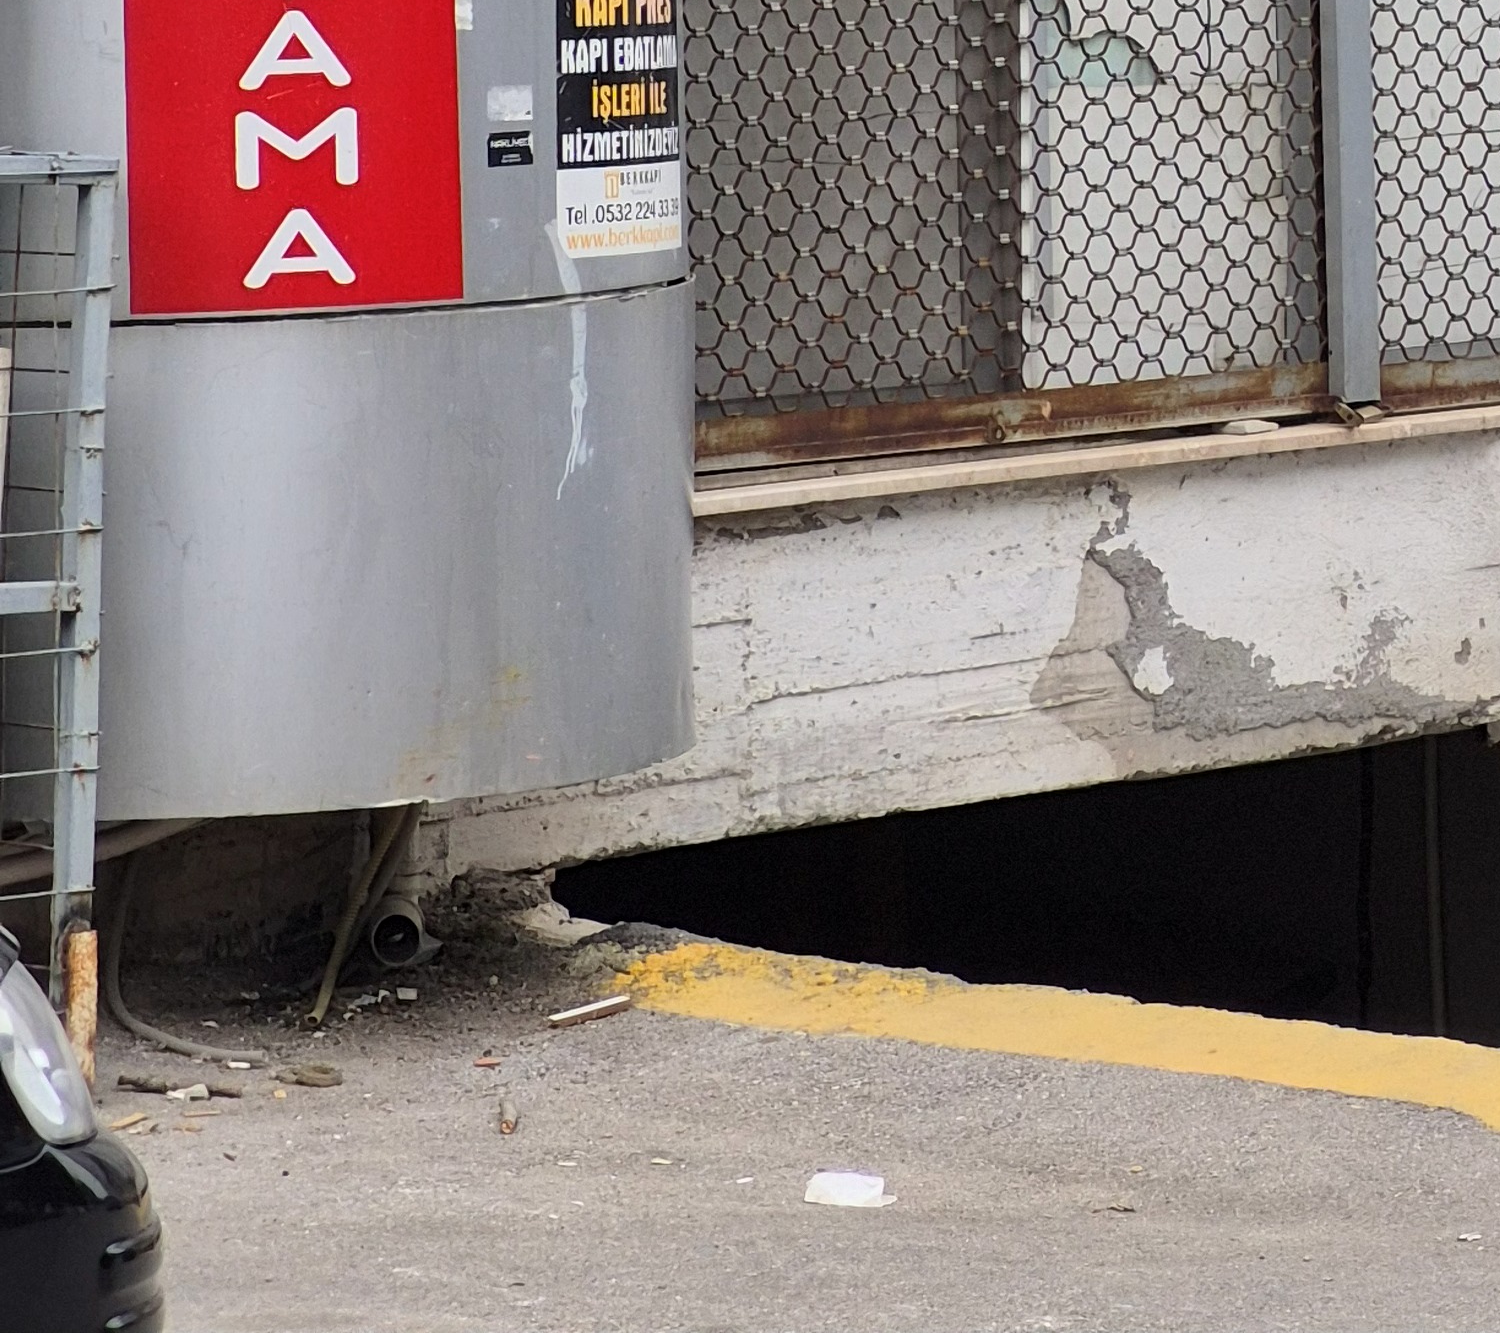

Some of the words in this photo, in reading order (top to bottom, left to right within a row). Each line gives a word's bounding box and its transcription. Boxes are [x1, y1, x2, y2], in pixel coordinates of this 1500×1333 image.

[560, 38, 609, 74] KAPI
[592, 75, 646, 126] İŞLERİ
[565, 203, 588, 226] Tel
[635, 200, 656, 221] 224
[658, 198, 670, 218] 33
